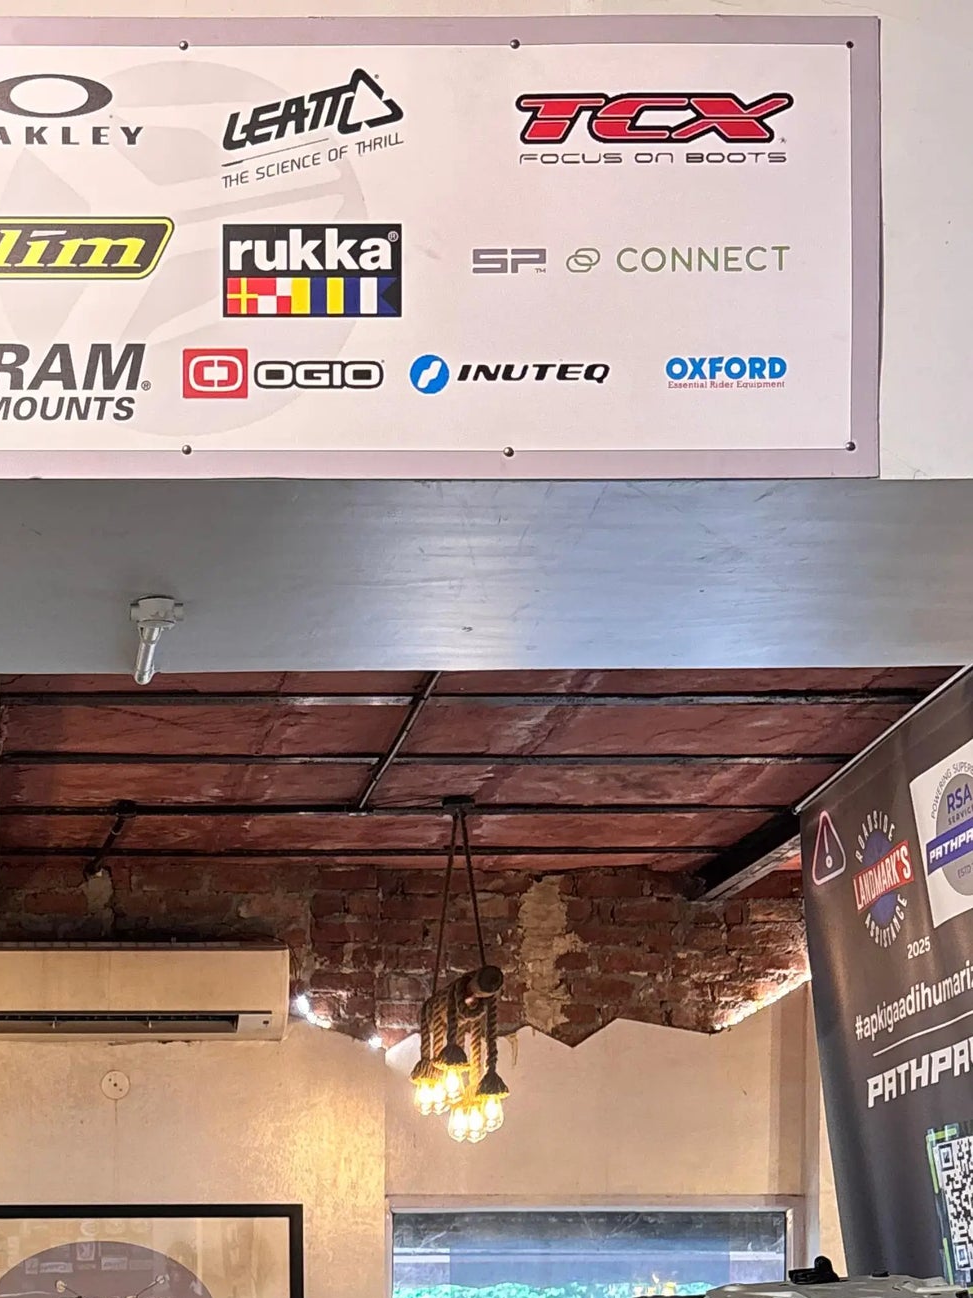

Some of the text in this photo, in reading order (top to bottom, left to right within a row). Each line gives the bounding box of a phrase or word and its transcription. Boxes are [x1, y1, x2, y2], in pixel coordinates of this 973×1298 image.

[515, 93, 794, 144] TCX
[222, 132, 404, 188] THE SCIENCE OF THRILL
[520, 153, 622, 164] FOCUS
[686, 152, 786, 163] BOOTS
[228, 228, 392, 271] rukka
[473, 246, 790, 273] SP CONNECT
[254, 360, 384, 389] OGIO
[457, 364, 610, 383] INUTEQ
[666, 356, 787, 379] OXFORD
[667, 380, 785, 389] Essential Rider Equipment
[946, 783, 972, 814] RSA
[855, 810, 895, 862] ROADSIDE
[853, 845, 912, 910] LANDMARK'S
[864, 895, 908, 948] ASSISTANCE
[906, 936, 931, 959] 2025
